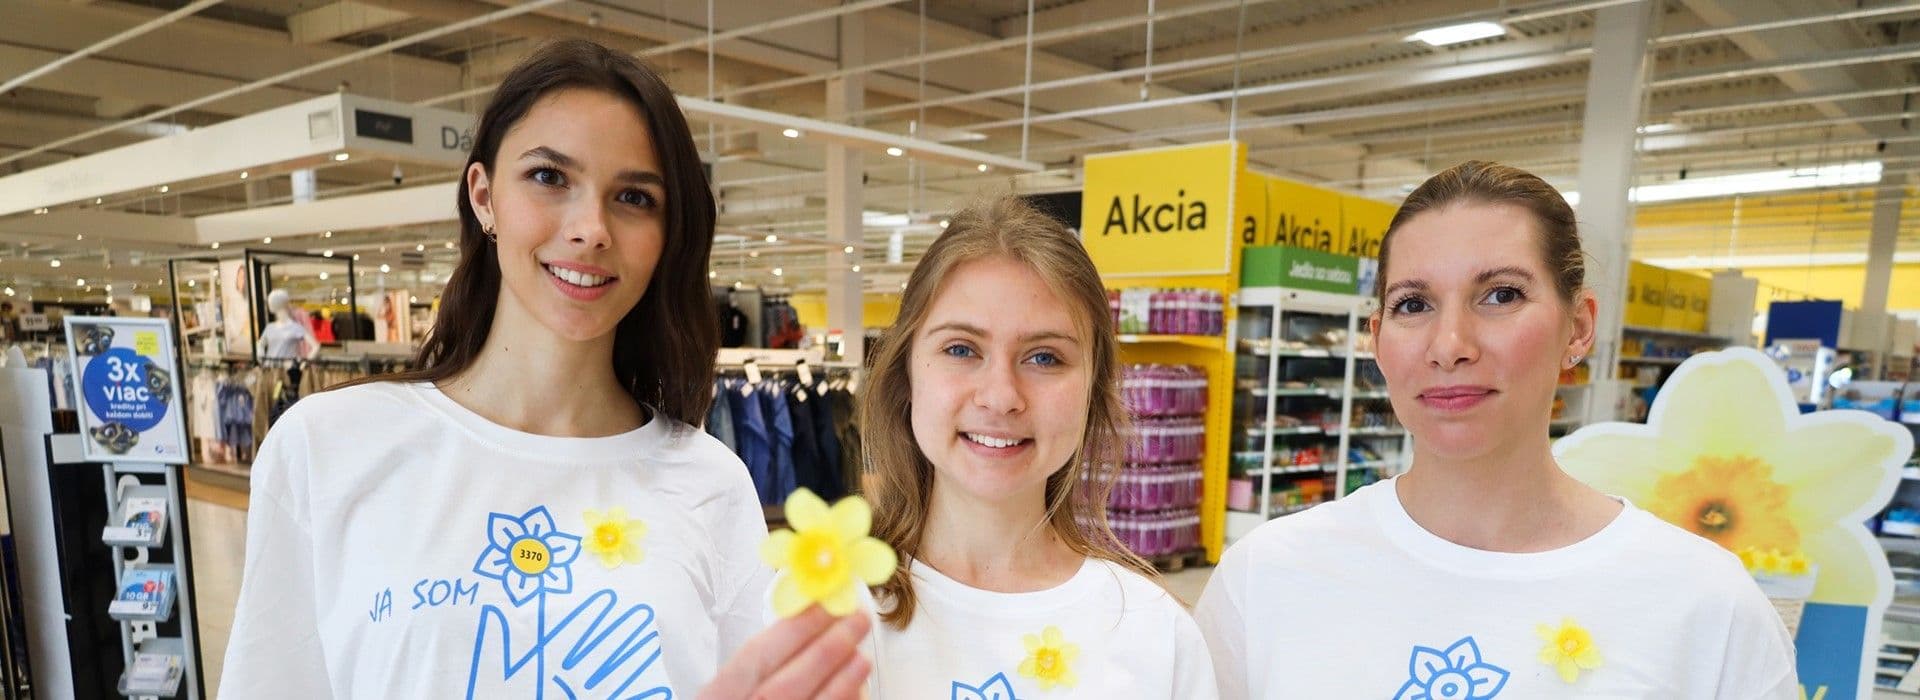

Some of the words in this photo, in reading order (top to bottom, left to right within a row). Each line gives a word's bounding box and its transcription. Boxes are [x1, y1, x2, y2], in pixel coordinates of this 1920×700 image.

[442, 127, 473, 152] Dá
[1103, 189, 1207, 235] Akcia
[1274, 213, 1332, 254] Akcia
[106, 356, 141, 382] 3x
[103, 381, 150, 402] viac
[520, 549, 542, 562] 3370
[369, 587, 393, 622] JA
[412, 578, 479, 610] SOM
